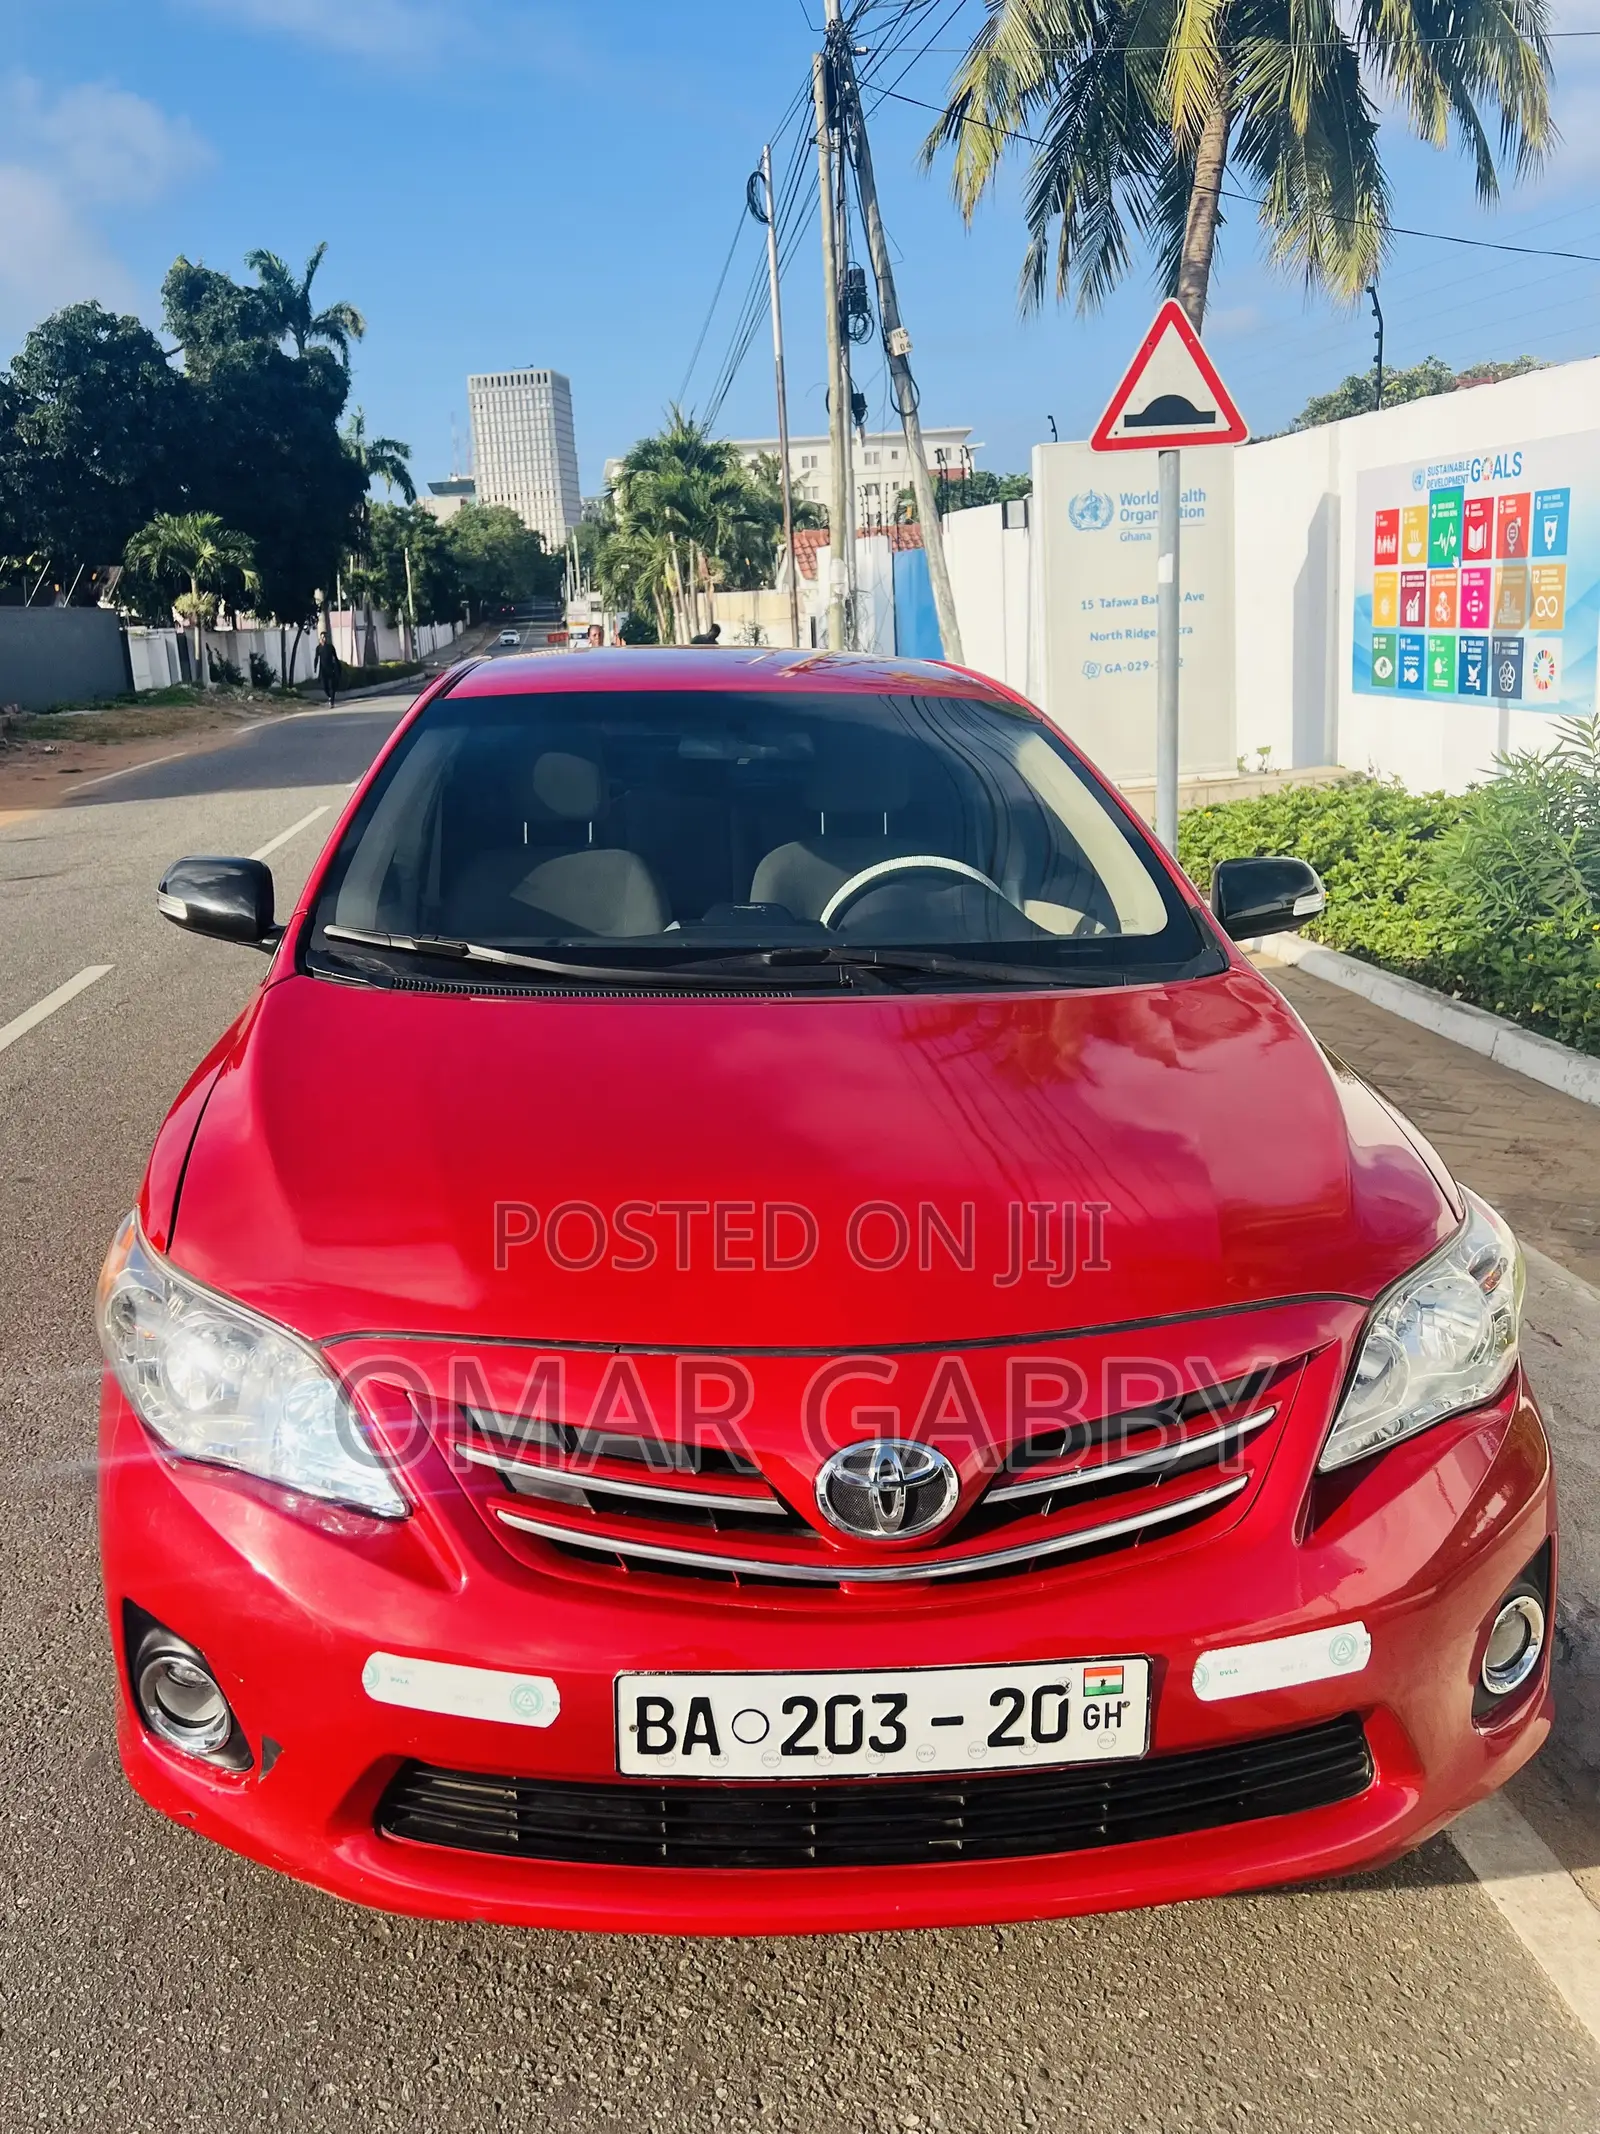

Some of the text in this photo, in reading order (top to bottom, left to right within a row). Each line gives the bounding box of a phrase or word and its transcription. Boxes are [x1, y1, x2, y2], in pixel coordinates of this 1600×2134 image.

[1427, 460, 1470, 476] SUSTAINABLE
[1471, 451, 1522, 482] GOALS
[1426, 474, 1469, 489] DEVELOPMENT
[1119, 488, 1206, 506] World alth
[1536, 496, 1542, 510] 6
[1431, 503, 1437, 519] 3
[1499, 500, 1504, 514] 5
[1119, 531, 1152, 542] Ghana
[1532, 570, 1540, 584] 12
[1081, 600, 1094, 610] 15
[1099, 597, 1139, 609] Tafawa
[1184, 592, 1205, 602] Ave
[1090, 630, 1123, 642] North
[1219, 1668, 1239, 1677] DVLA
[636, 1695, 722, 1756] BA
[781, 1692, 908, 1756] 203
[987, 1683, 1069, 1748] 20
[1083, 1699, 1123, 1731] GH
